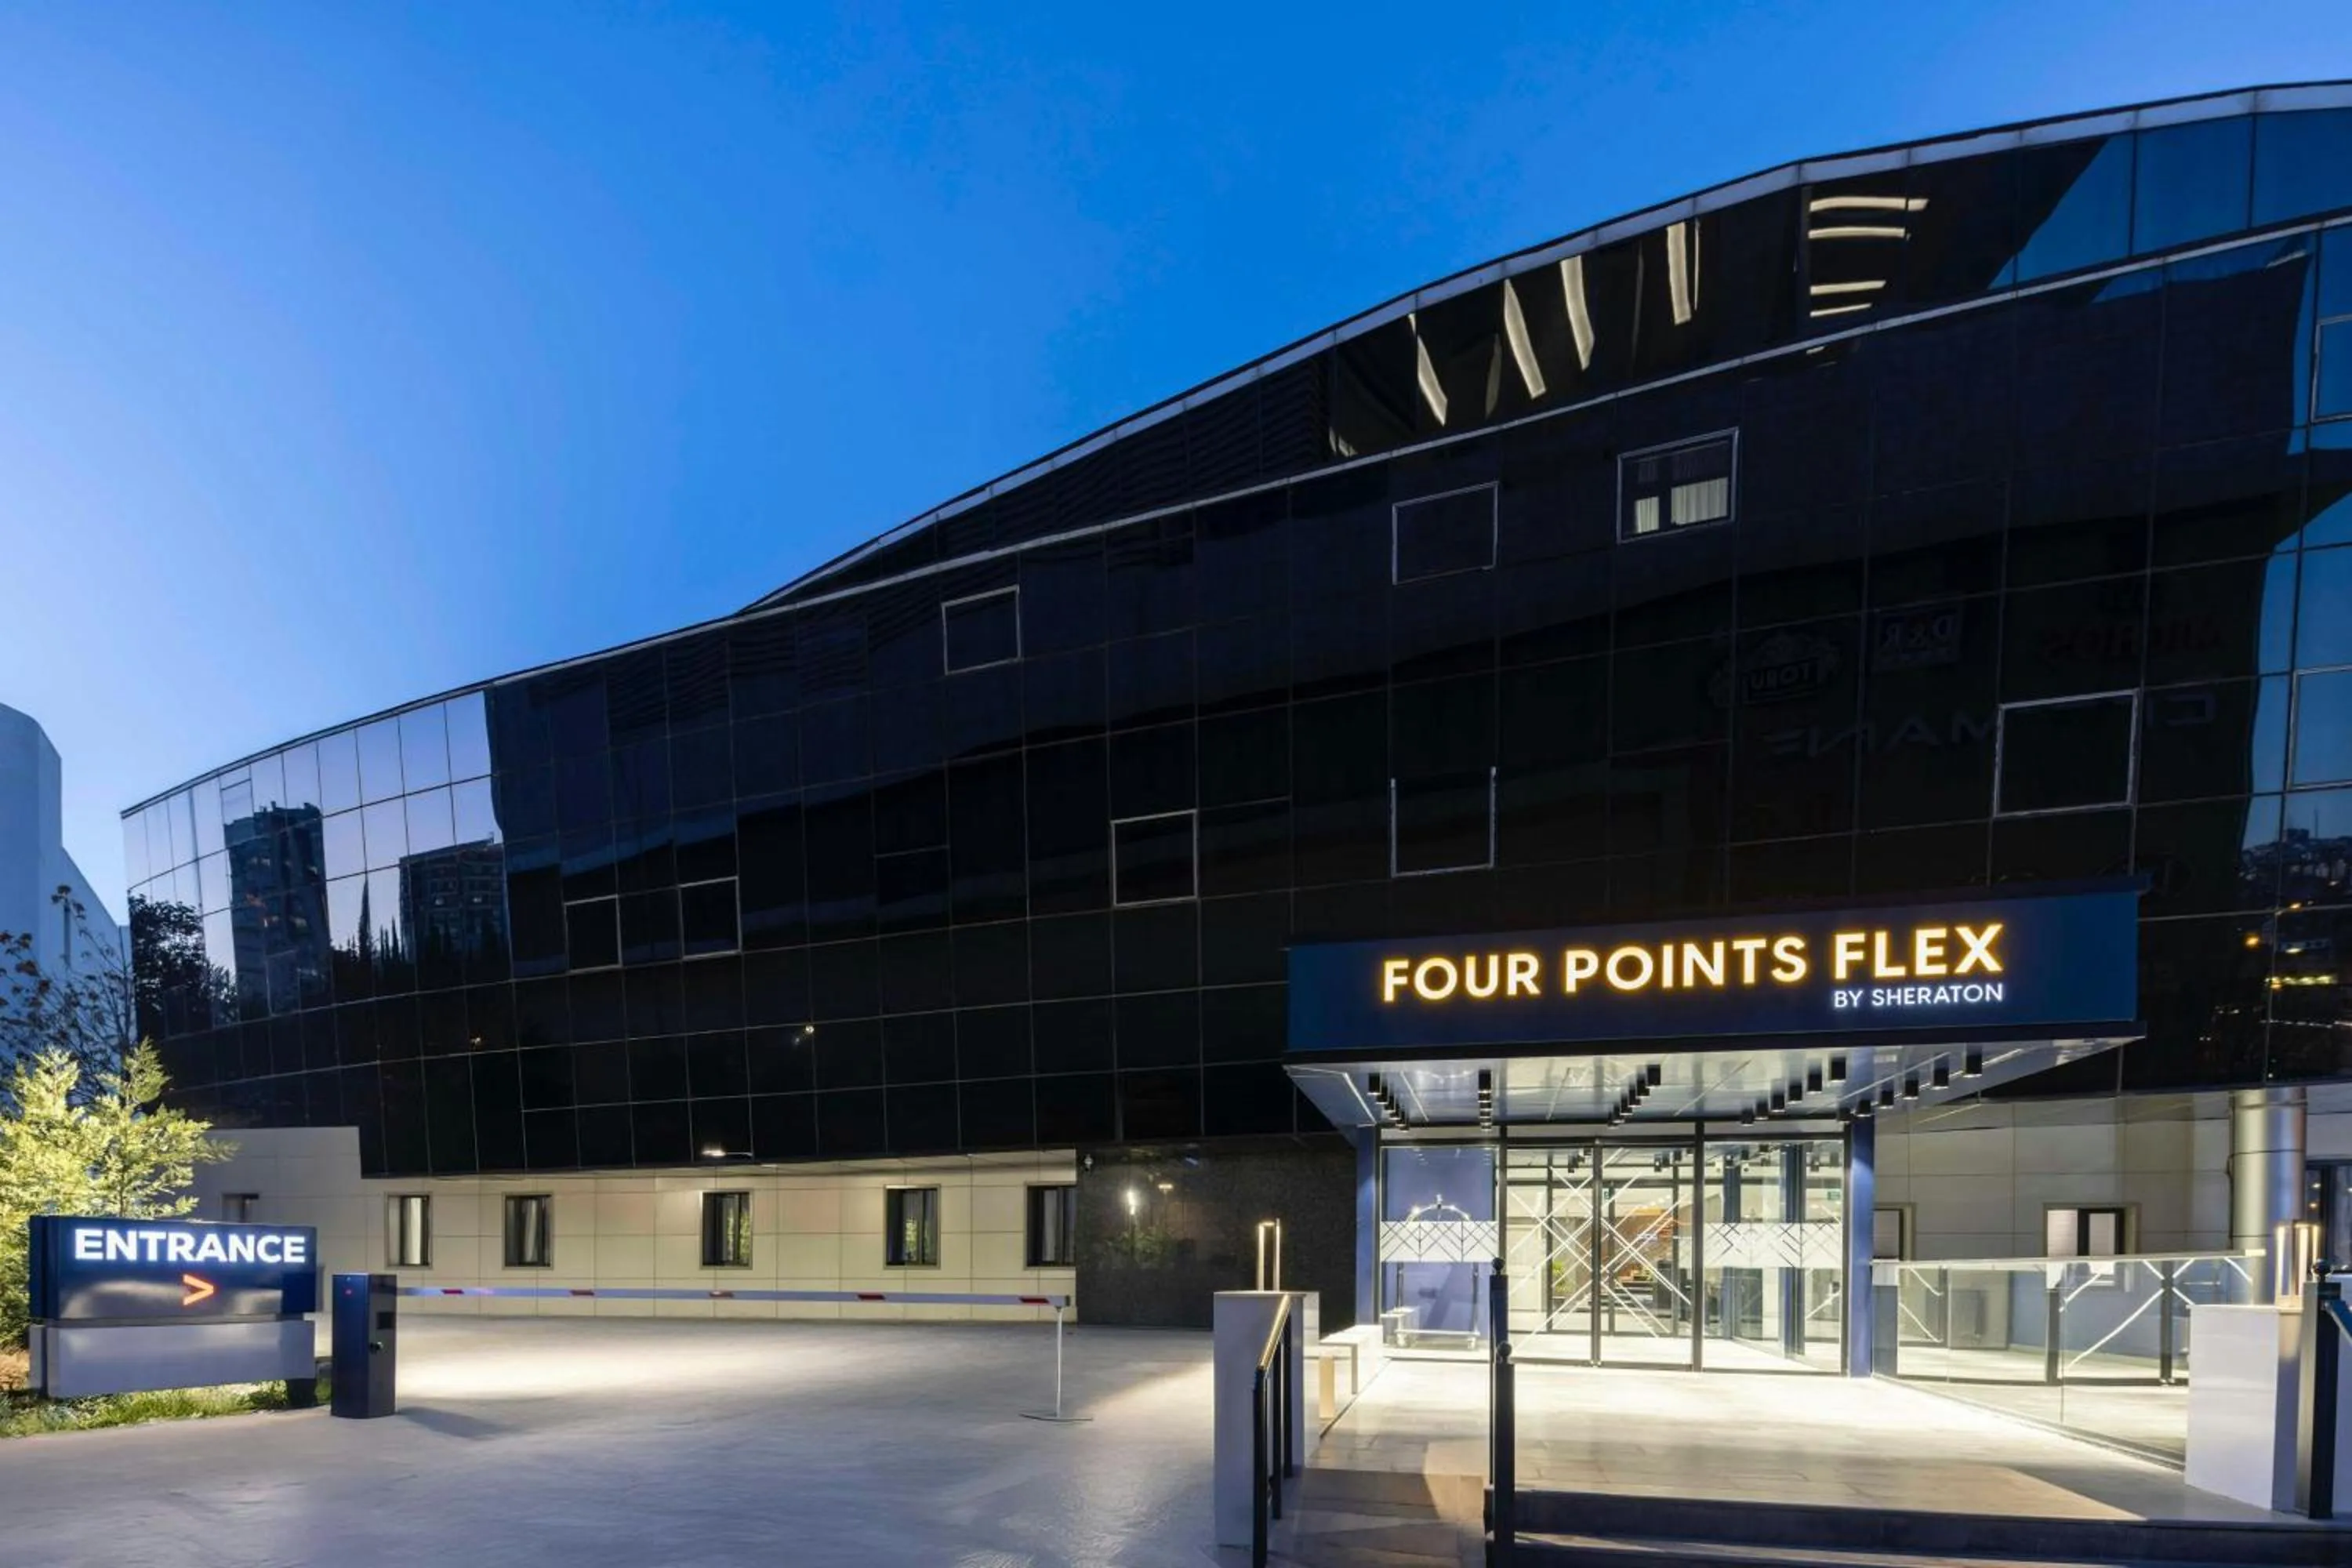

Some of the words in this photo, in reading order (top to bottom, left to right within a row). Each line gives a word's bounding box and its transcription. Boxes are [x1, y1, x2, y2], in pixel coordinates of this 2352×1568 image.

[1384, 953, 1541, 1002] FOUR
[1565, 936, 1807, 993] POINTS
[1835, 924, 2003, 980] FLEX
[1833, 989, 1864, 1009] BY
[1871, 982, 2004, 1007] SHERATON
[74, 1229, 306, 1264] ENTRANCE
